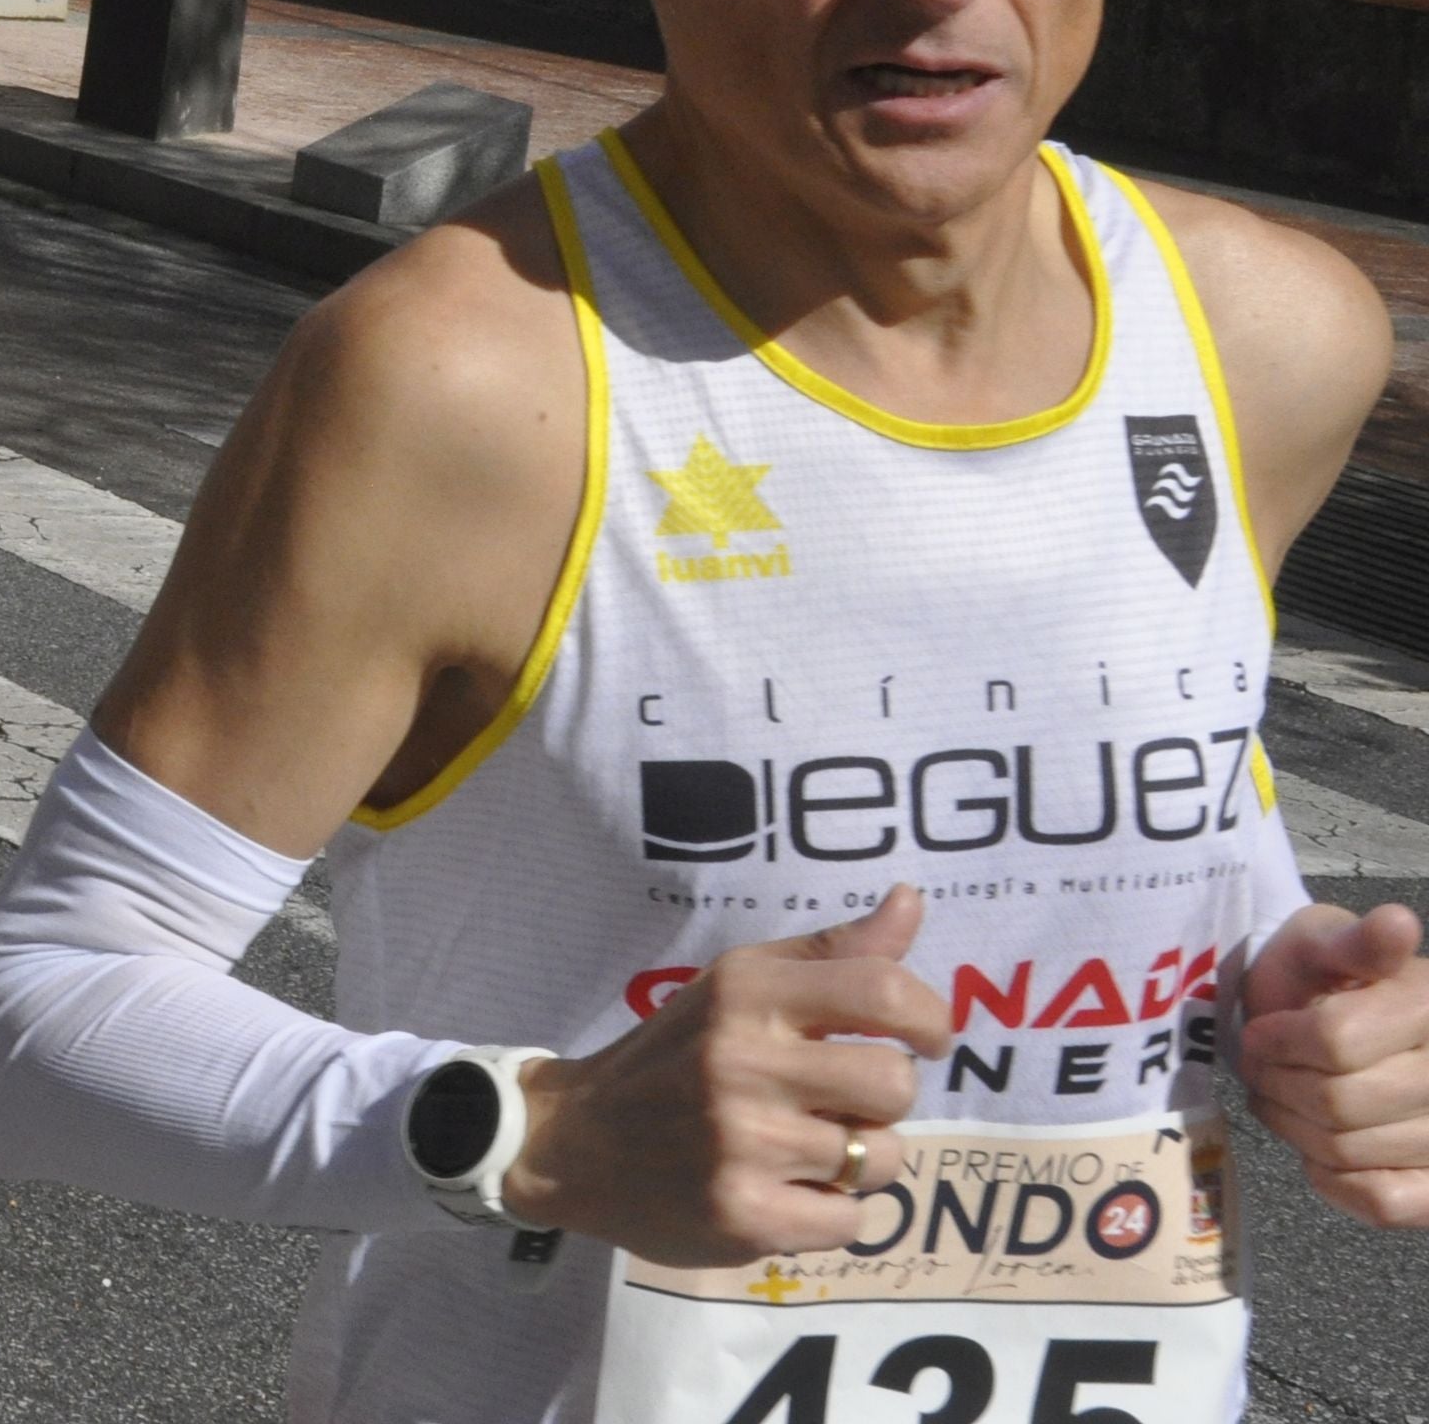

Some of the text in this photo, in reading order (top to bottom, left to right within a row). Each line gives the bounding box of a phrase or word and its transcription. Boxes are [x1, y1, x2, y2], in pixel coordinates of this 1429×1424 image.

[656, 542, 791, 585] luanvi
[647, 885, 758, 913] Centro
[783, 889, 822, 913] de
[937, 1149, 1103, 1188] PREMIO
[851, 1179, 1161, 1260] ONDO
[1095, 1202, 1149, 1237] 24
